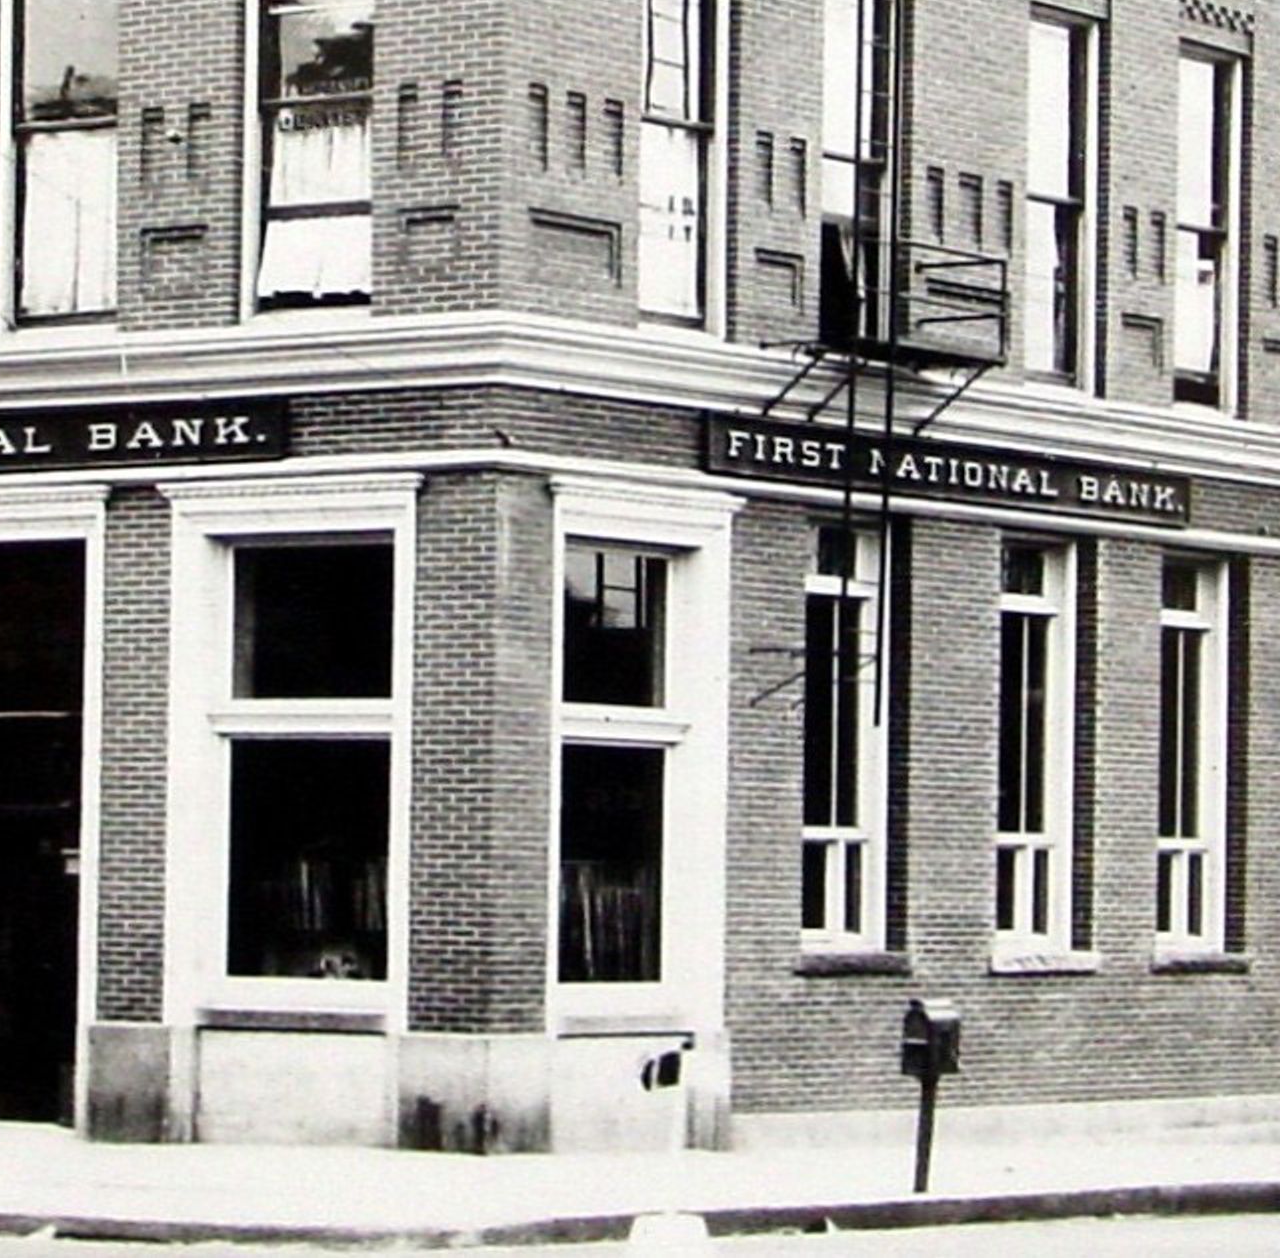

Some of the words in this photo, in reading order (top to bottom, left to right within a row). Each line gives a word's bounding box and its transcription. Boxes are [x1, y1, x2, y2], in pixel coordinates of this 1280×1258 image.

[88, 416, 266, 451] BANK.
[728, 430, 846, 470] FIRST
[1080, 475, 1185, 513] BANK.
